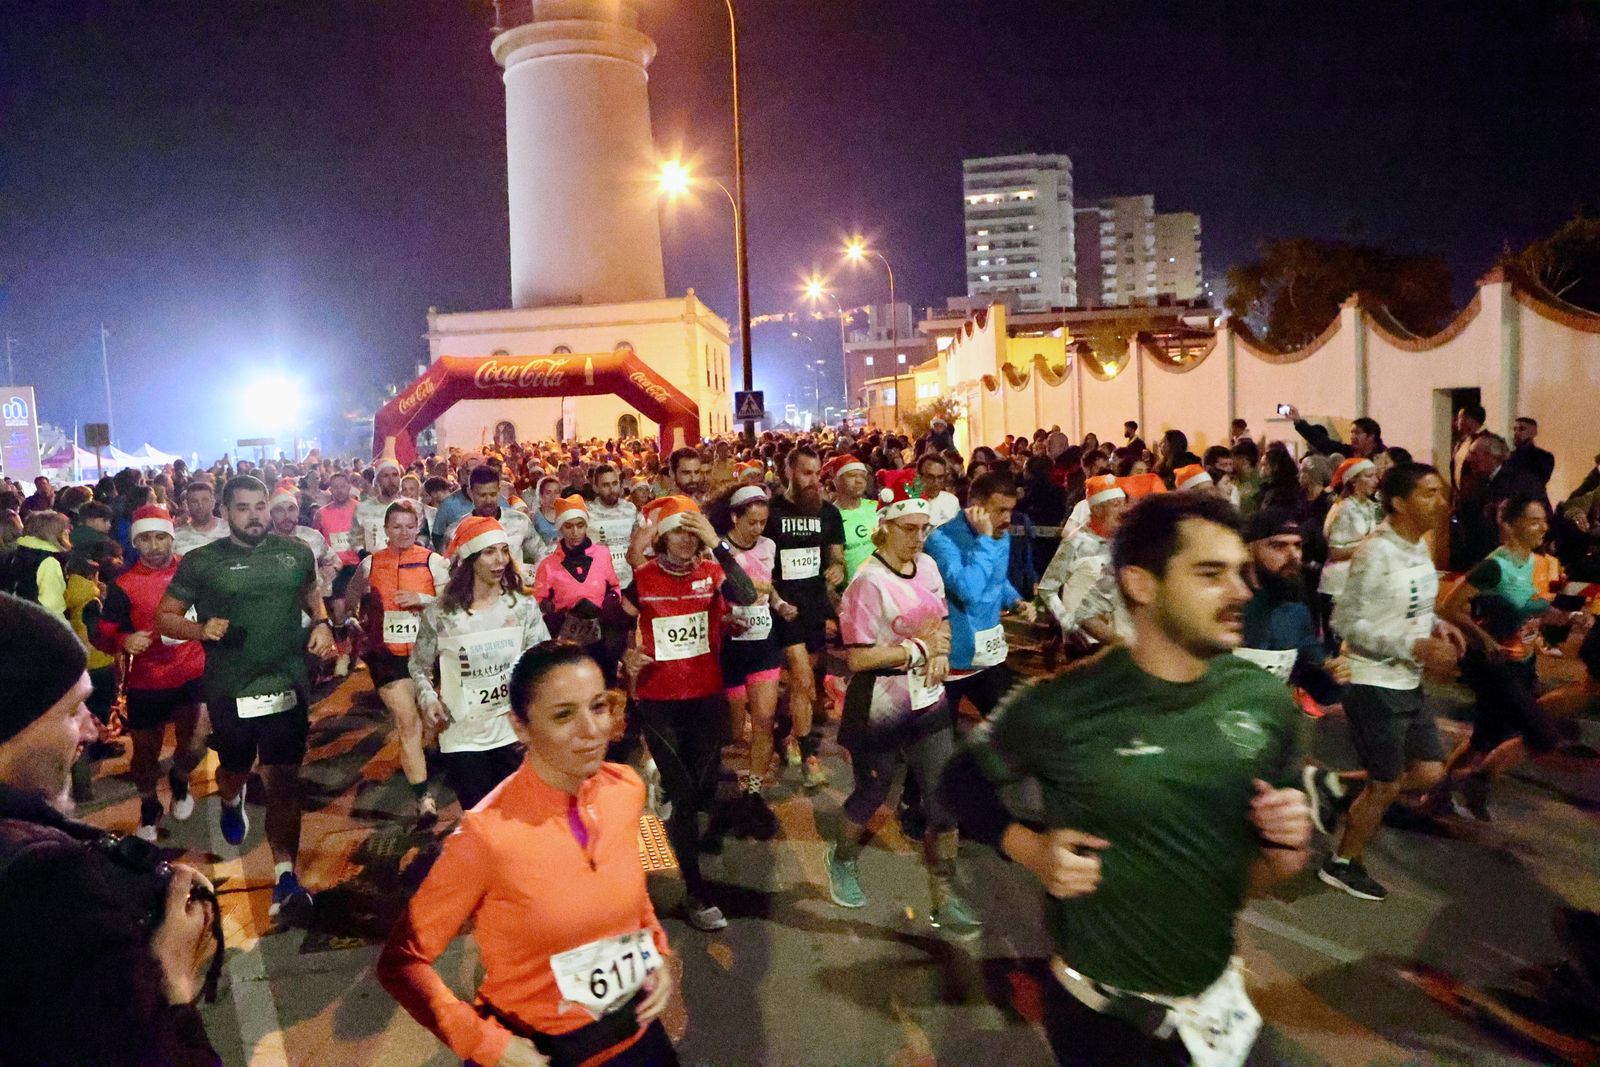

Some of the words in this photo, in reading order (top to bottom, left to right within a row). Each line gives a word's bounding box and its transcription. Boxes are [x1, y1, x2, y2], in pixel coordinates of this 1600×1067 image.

[474, 358, 571, 389] Coca-Cola
[399, 378, 435, 415] Coca-Cola
[630, 371, 671, 403] Coca-Cola
[792, 557, 812, 567] 1120
[389, 624, 417, 633] 1211
[667, 626, 698, 643] 924
[479, 683, 509, 705] 248
[590, 952, 636, 999] 617
